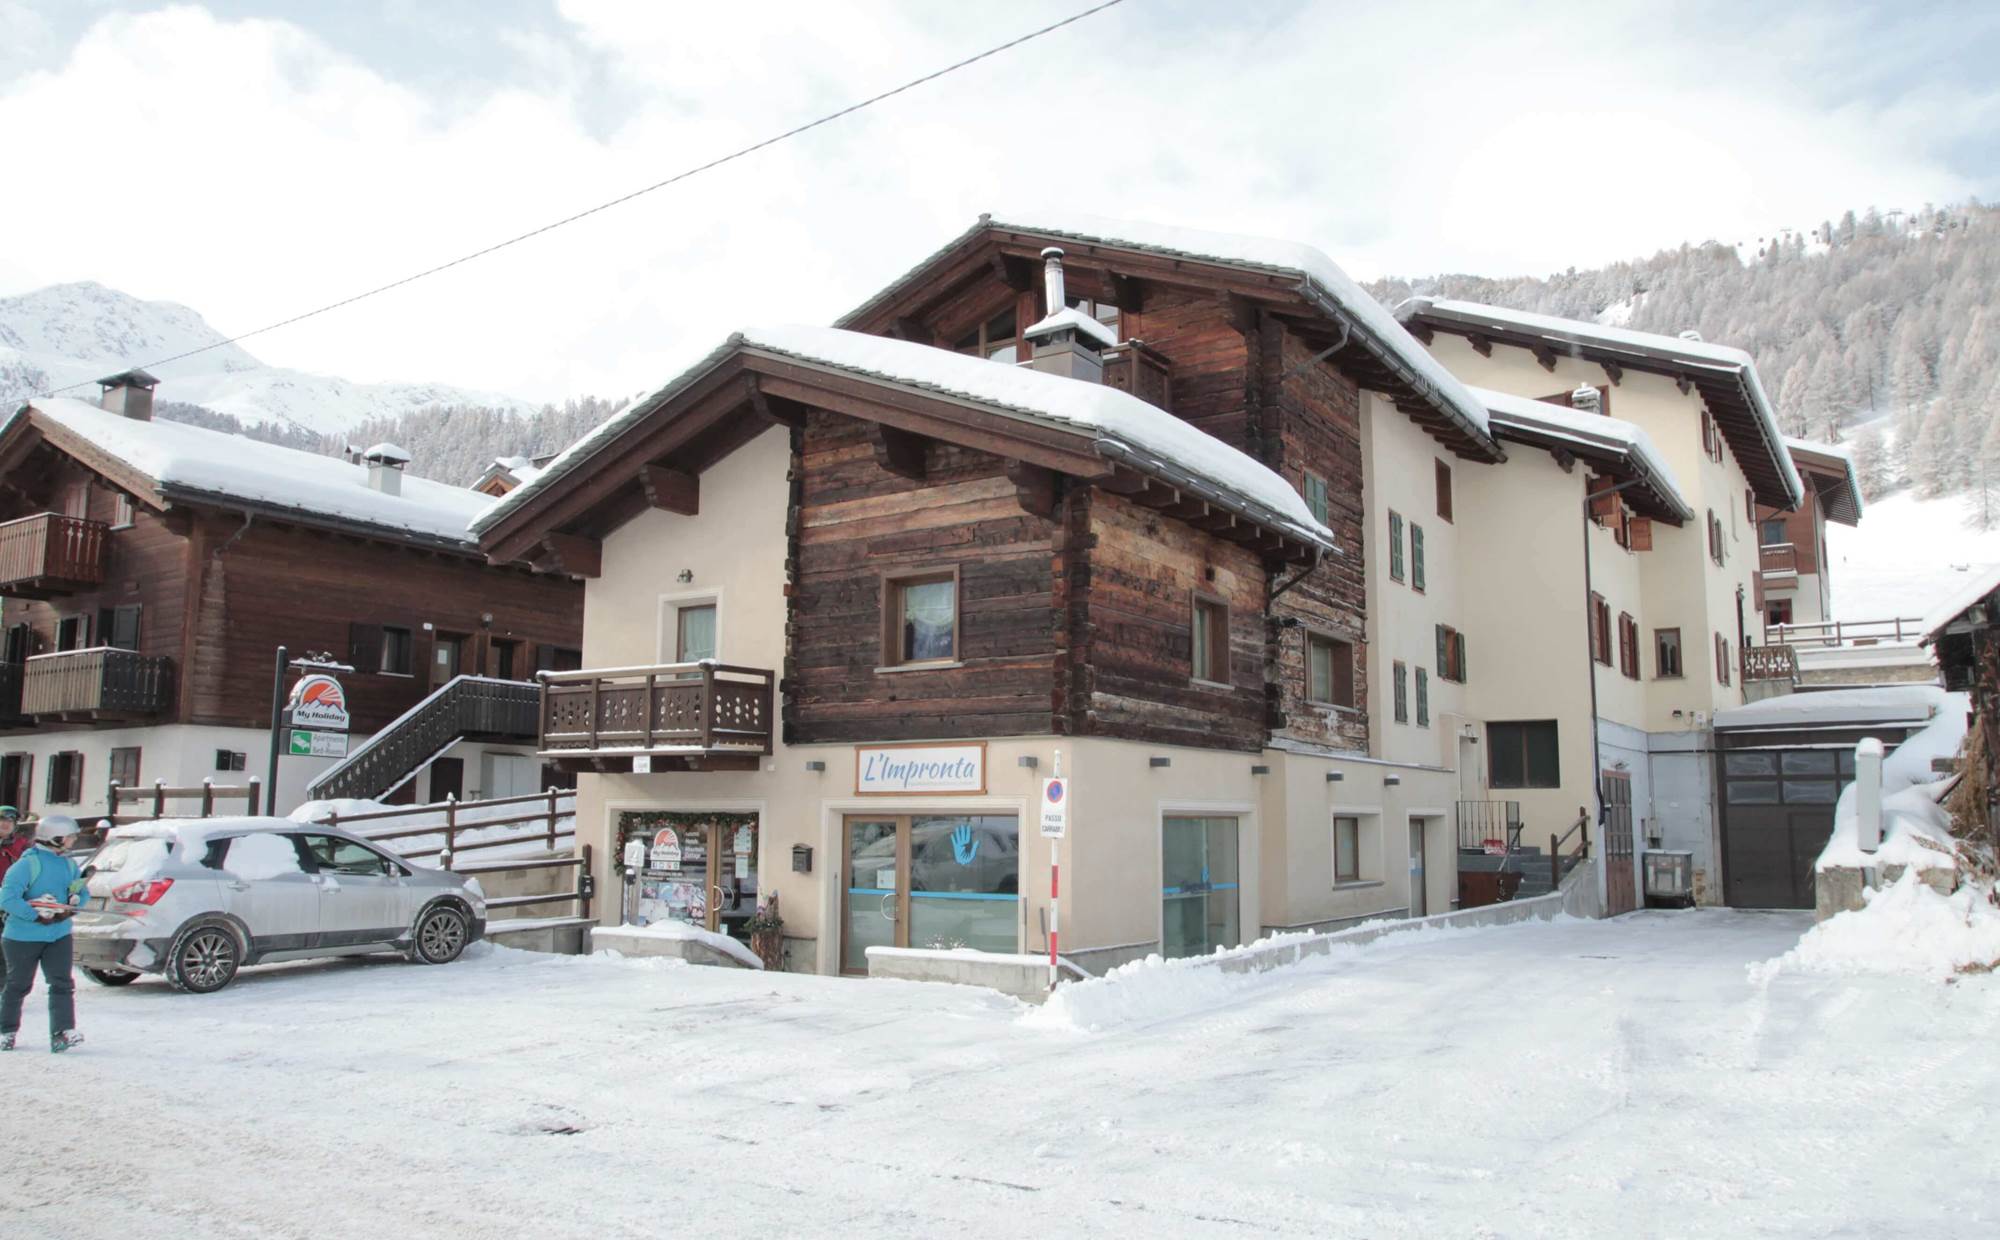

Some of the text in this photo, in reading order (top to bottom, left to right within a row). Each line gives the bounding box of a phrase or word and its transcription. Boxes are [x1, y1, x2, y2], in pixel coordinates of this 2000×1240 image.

[297, 711, 345, 721] My Holiday
[865, 753, 975, 788] L'Impronta
[1045, 814, 1062, 822] PASSO
